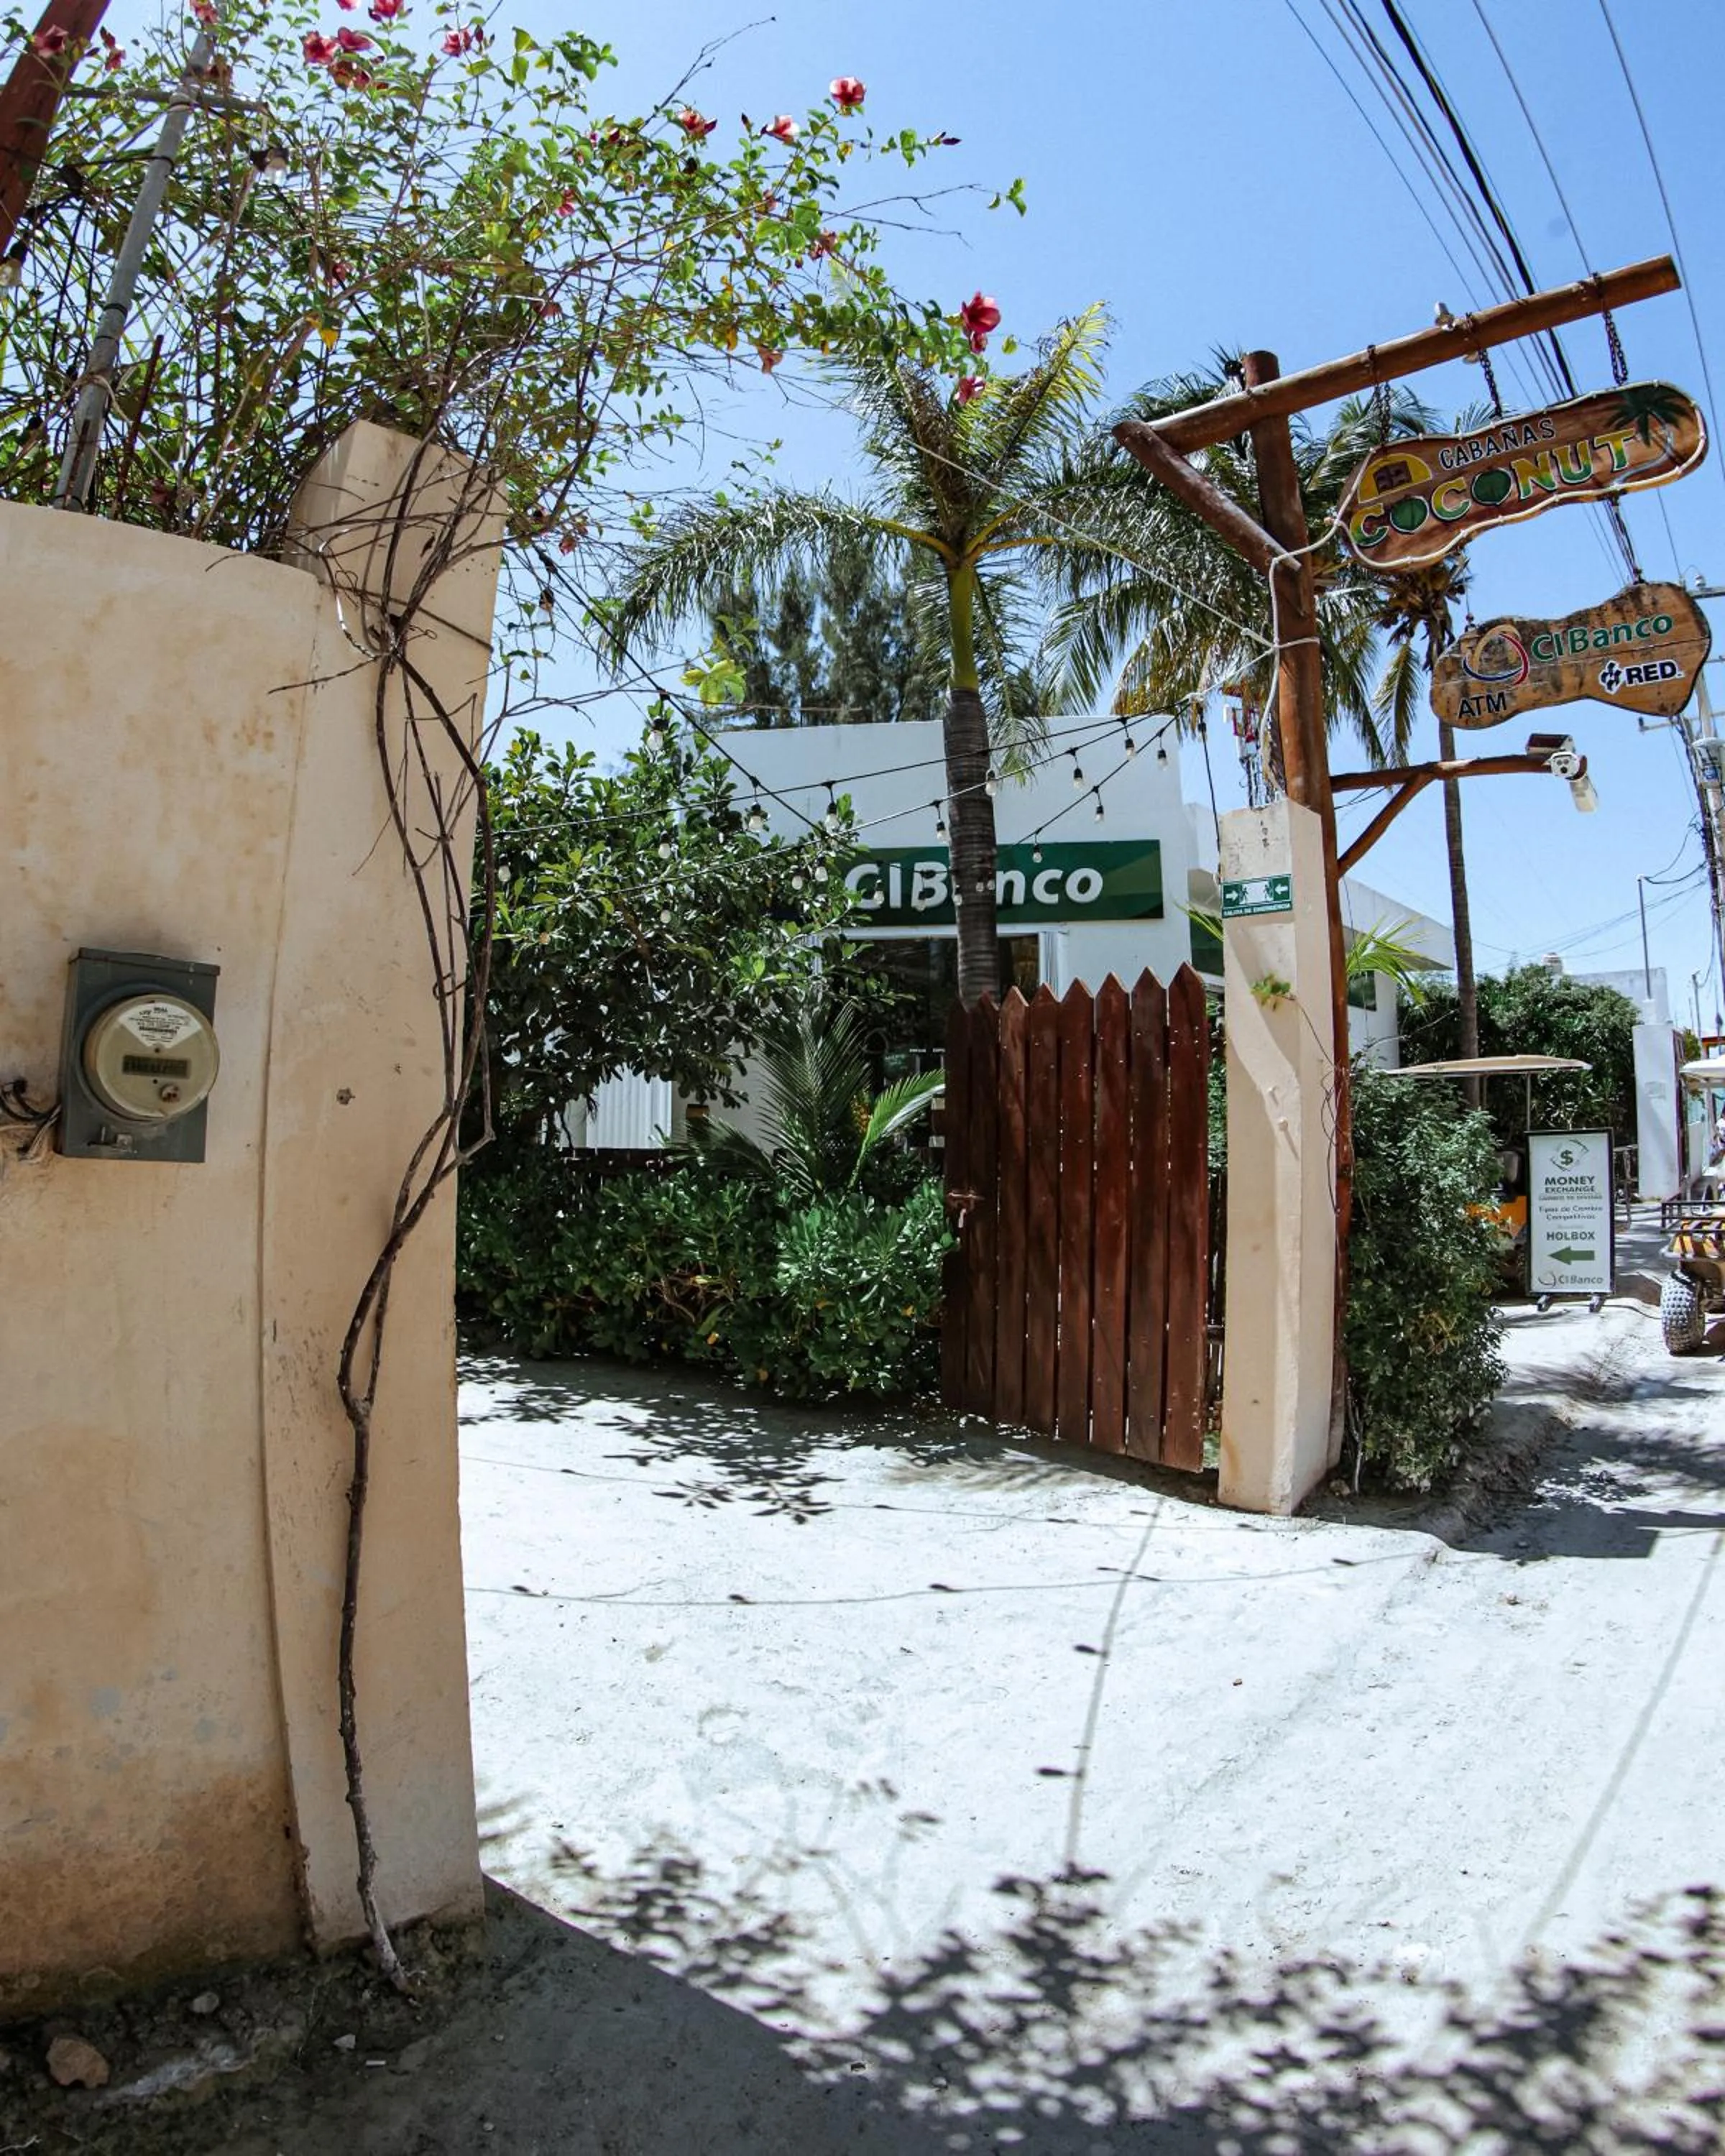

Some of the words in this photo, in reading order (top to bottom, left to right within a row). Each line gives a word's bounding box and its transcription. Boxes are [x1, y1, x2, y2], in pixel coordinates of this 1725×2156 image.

[1438, 418, 1556, 471] CABAÑAS
[1348, 429, 1635, 548] COCONUT
[1531, 614, 1674, 663] CIBanco
[1458, 691, 1507, 719] ATM
[844, 860, 1104, 911] CIBnco
[1545, 1176, 1595, 1186] MONEY
[1546, 1231, 1596, 1241] HOLBOX
